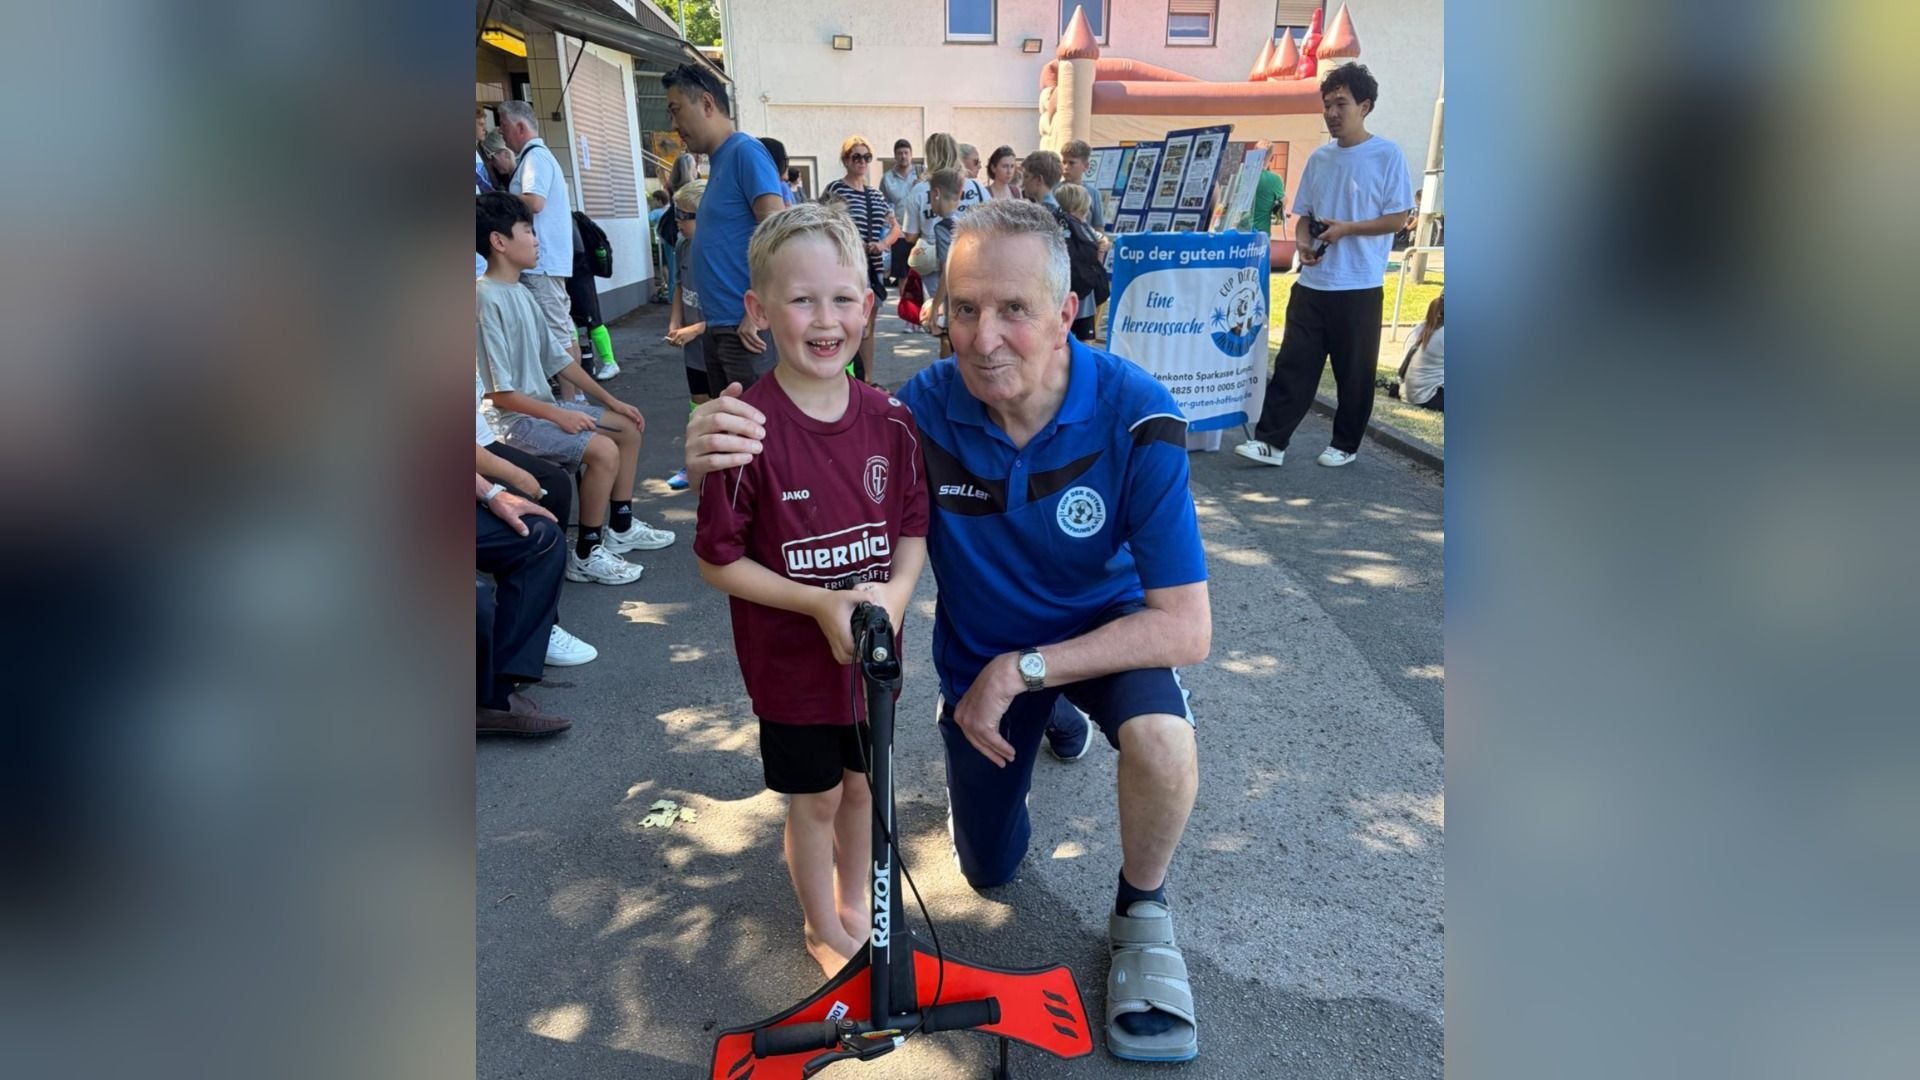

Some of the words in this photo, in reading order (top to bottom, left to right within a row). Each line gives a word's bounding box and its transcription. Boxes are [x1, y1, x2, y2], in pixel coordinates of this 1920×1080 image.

[1119, 246, 1145, 263] Cup
[1149, 245, 1175, 261] der
[1179, 248, 1225, 264] guten
[1220, 277, 1234, 297] CUP
[1146, 290, 1175, 309] Eine
[1121, 315, 1206, 336] Herzenssache
[1194, 384, 1216, 394] 0110
[781, 489, 810, 501] JAKO
[788, 530, 890, 570] wernic
[871, 860, 889, 948] Razor
